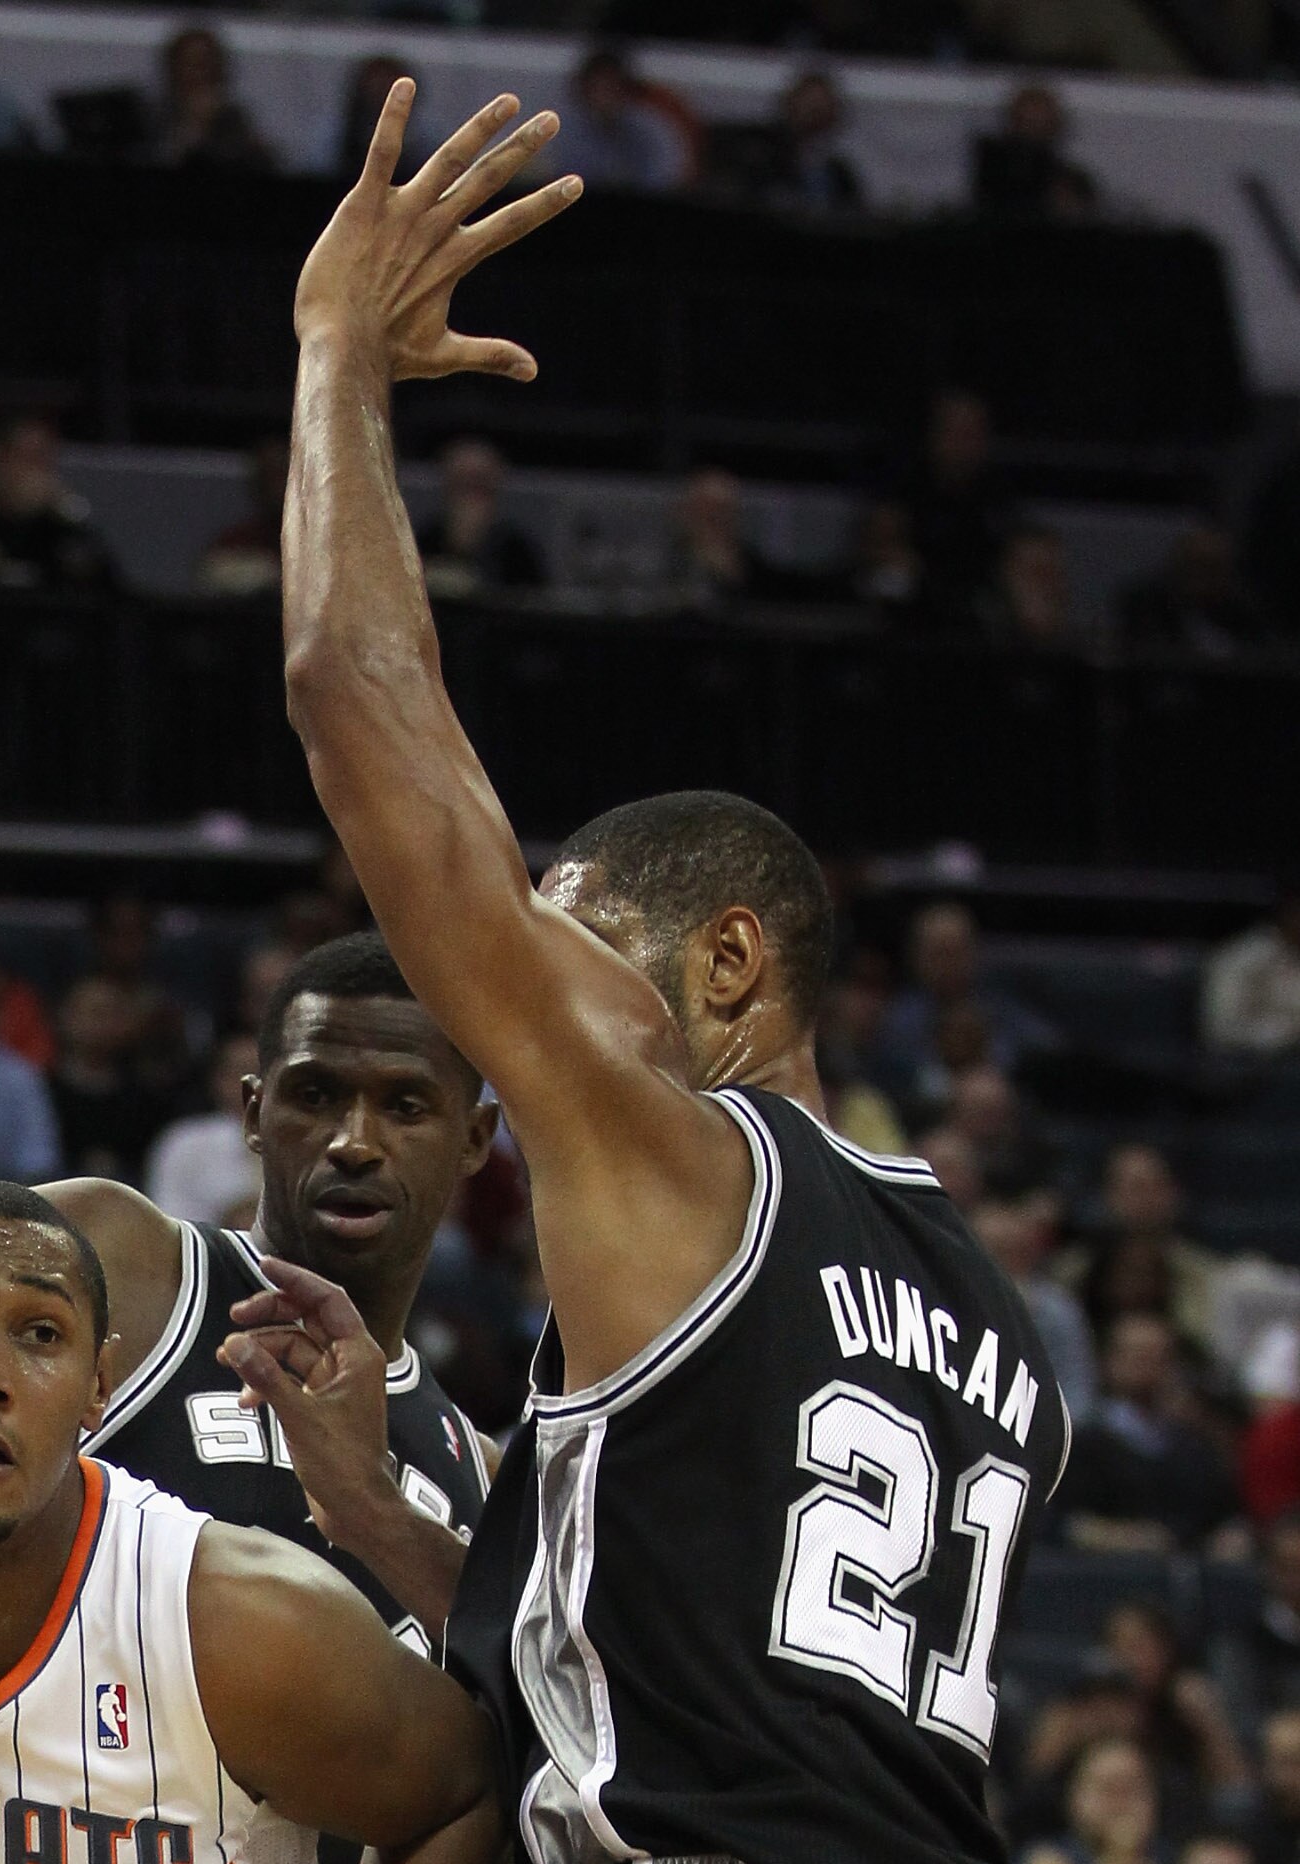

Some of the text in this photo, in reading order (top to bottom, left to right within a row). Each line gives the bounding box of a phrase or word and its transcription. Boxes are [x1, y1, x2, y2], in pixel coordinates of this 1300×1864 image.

[819, 1264, 1039, 1448] DUNCAN
[767, 1378, 1030, 1763] 21
[100, 1735, 120, 1747] NBA
